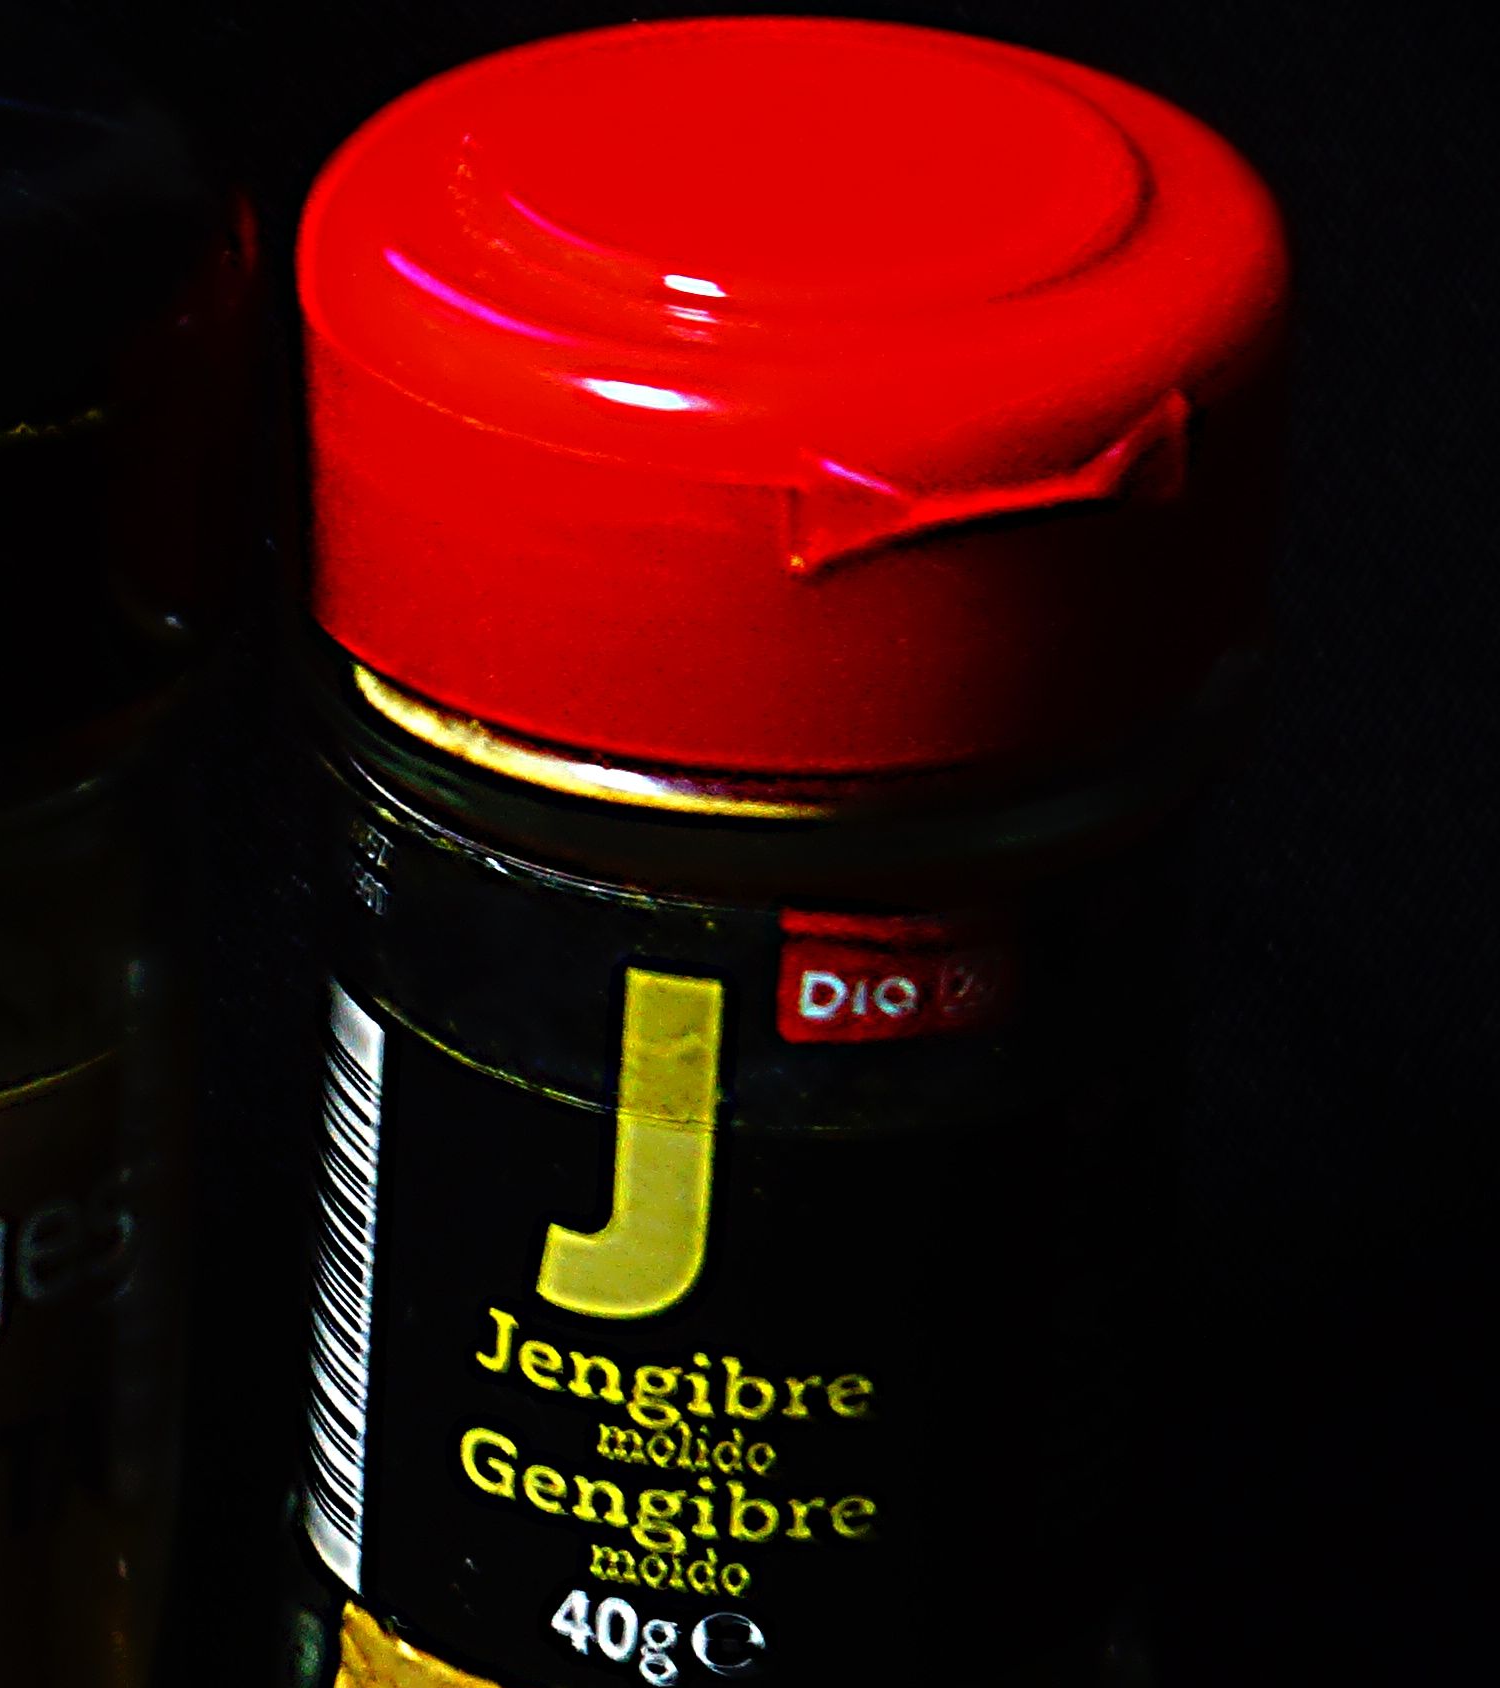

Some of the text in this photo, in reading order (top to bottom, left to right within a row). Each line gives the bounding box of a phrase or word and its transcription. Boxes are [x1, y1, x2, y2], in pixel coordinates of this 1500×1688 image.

[536, 966, 723, 1318] J
[476, 1307, 876, 1430] Jengibre
[460, 1427, 878, 1554] Gengibre
[597, 1421, 778, 1477] molido
[551, 1589, 682, 1687] 40g
